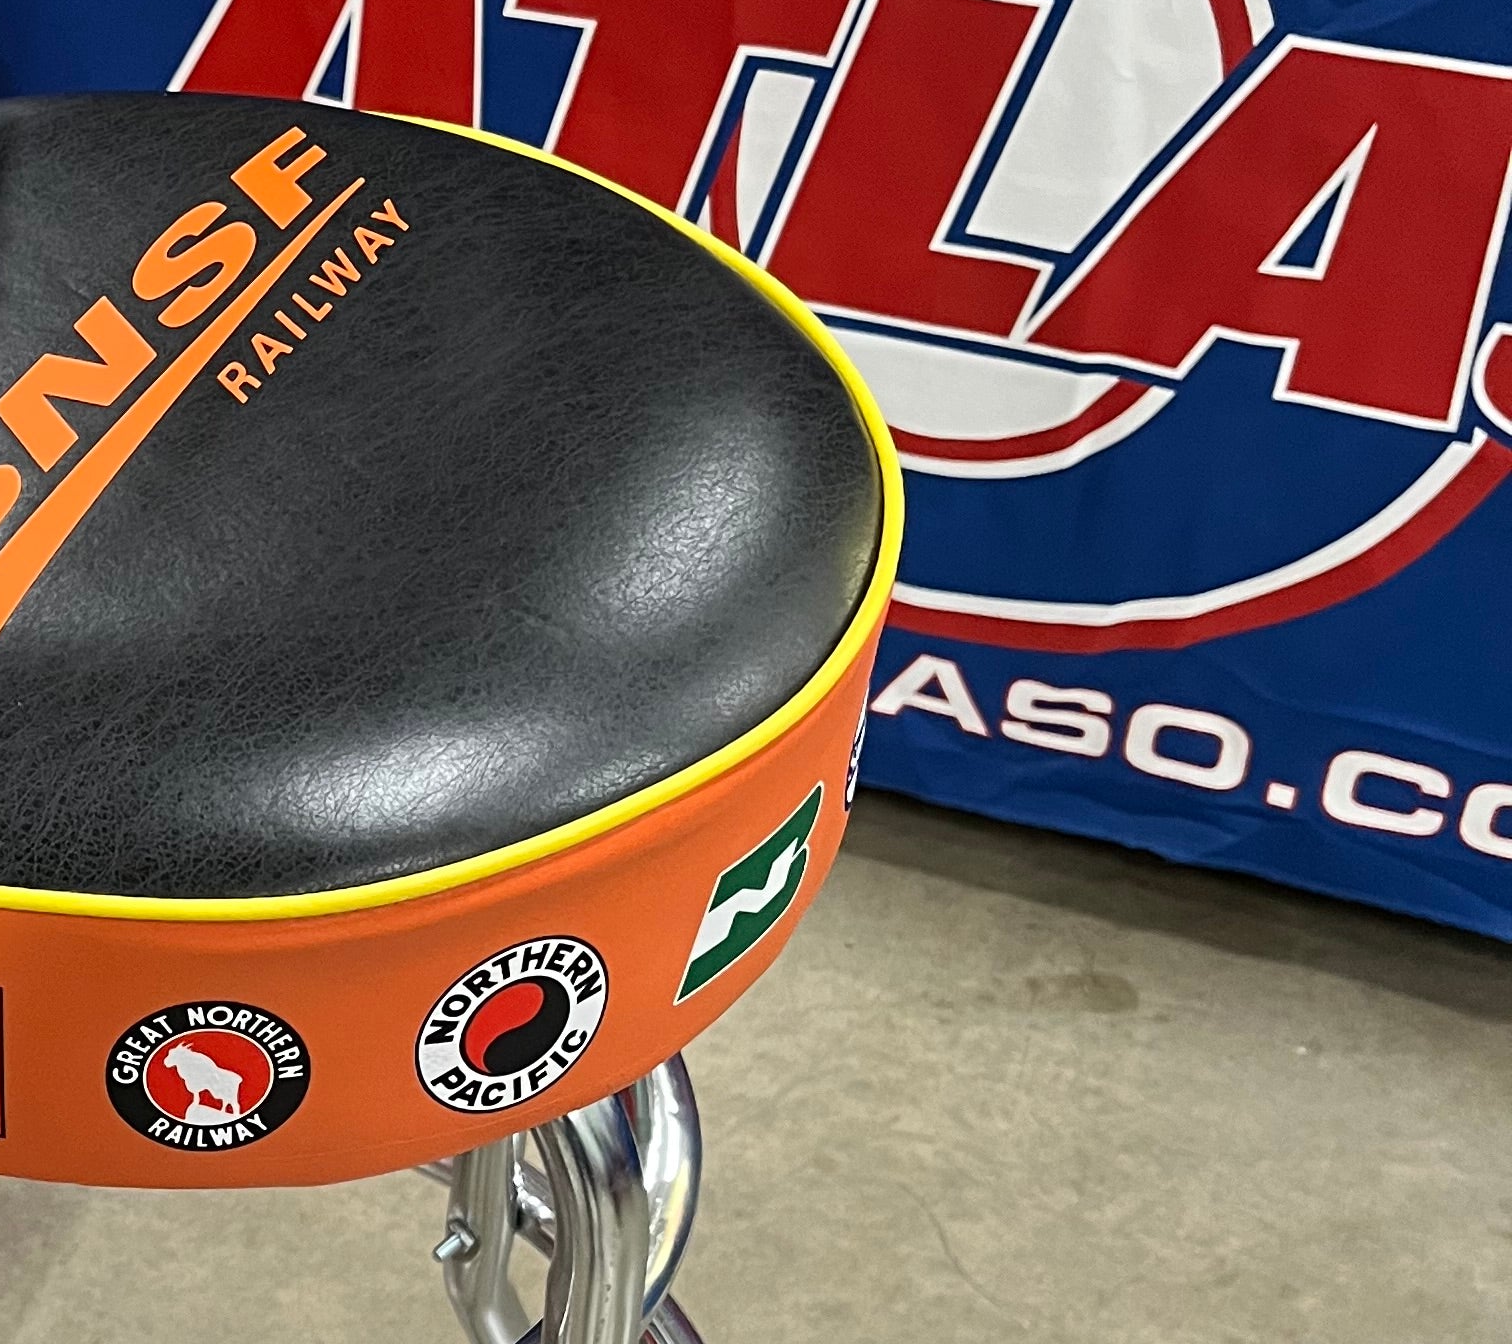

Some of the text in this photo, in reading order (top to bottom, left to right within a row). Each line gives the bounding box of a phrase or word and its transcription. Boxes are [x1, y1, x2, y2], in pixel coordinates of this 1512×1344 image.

[216, 198, 410, 405] RAILWAY
[424, 943, 603, 1045] NORTHERN
[112, 1006, 304, 1084] GREAT NORTHERN
[430, 1028, 589, 1107] PACIFIC
[147, 1113, 268, 1148] RAILWAY
